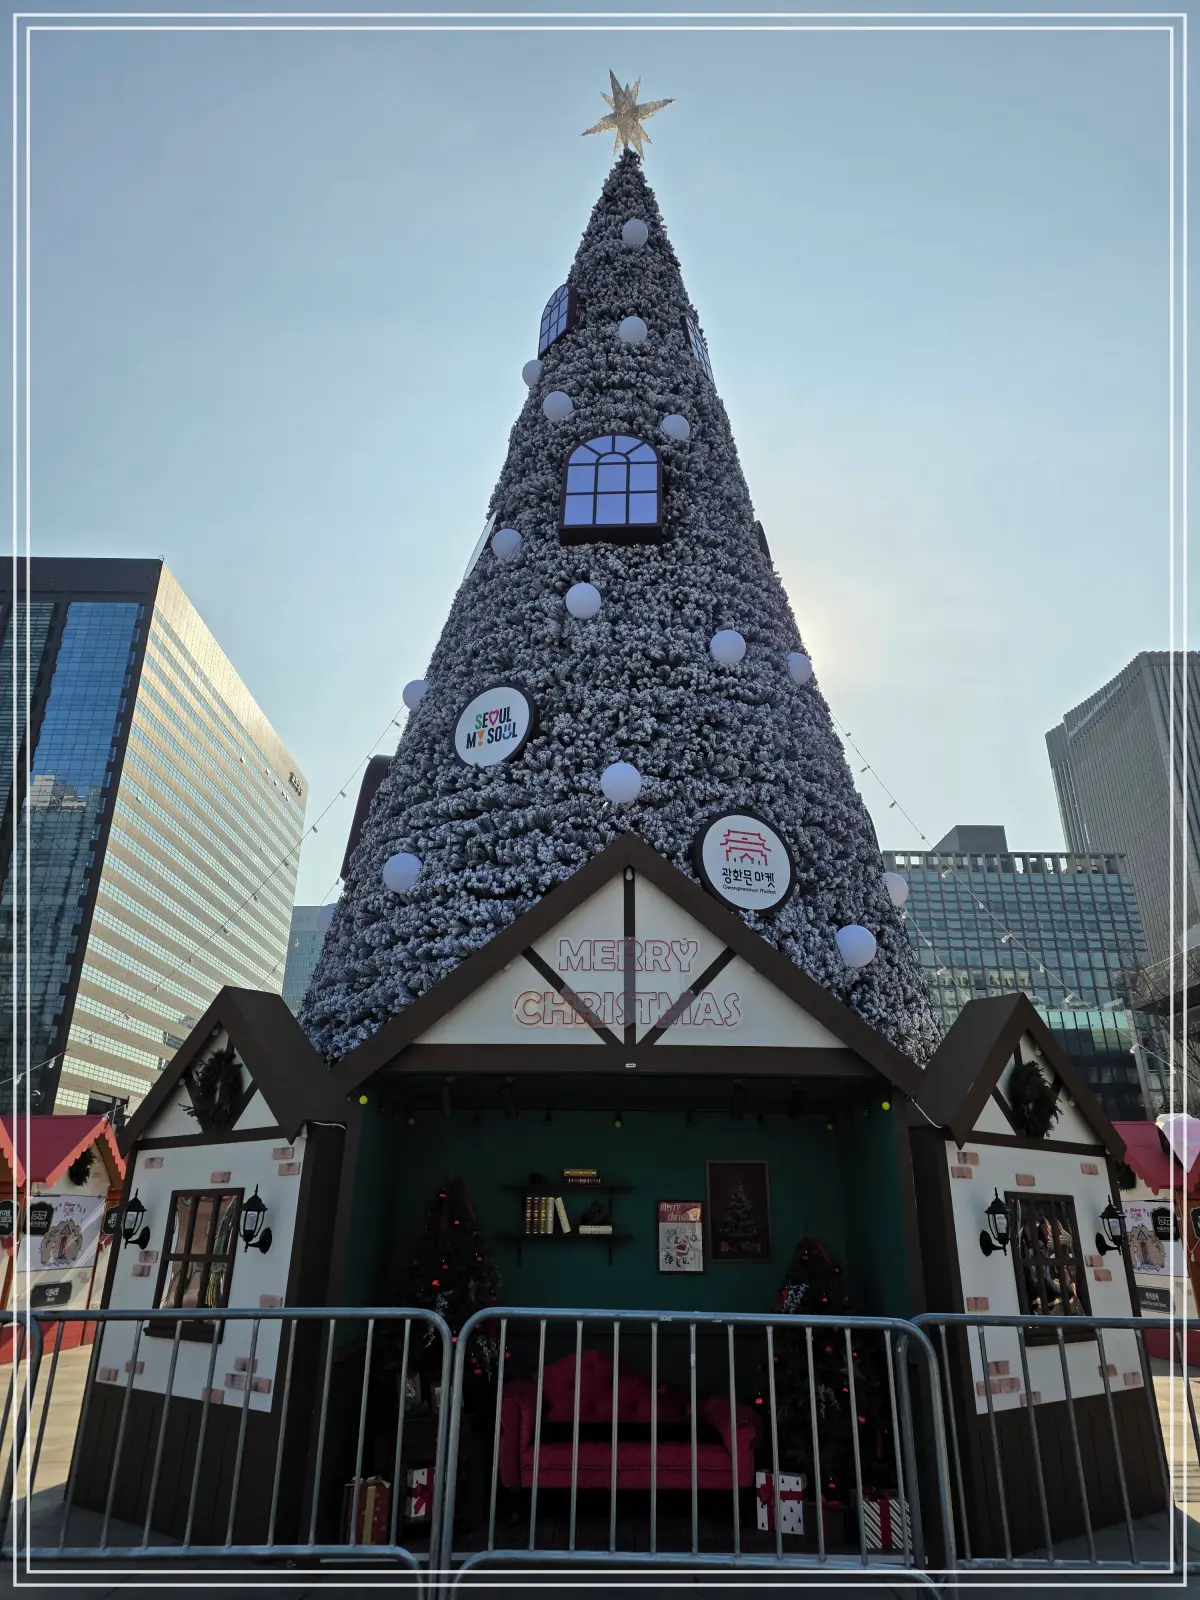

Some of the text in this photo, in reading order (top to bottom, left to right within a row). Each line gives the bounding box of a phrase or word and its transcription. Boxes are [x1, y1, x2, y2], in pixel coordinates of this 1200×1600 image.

[475, 706, 512, 730] SEOUL
[487, 722, 518, 744] SOUL
[721, 868, 776, 888] 광화문 마켓
[558, 939, 698, 972] MERRY
[513, 990, 742, 1027] CHRISTMAS
